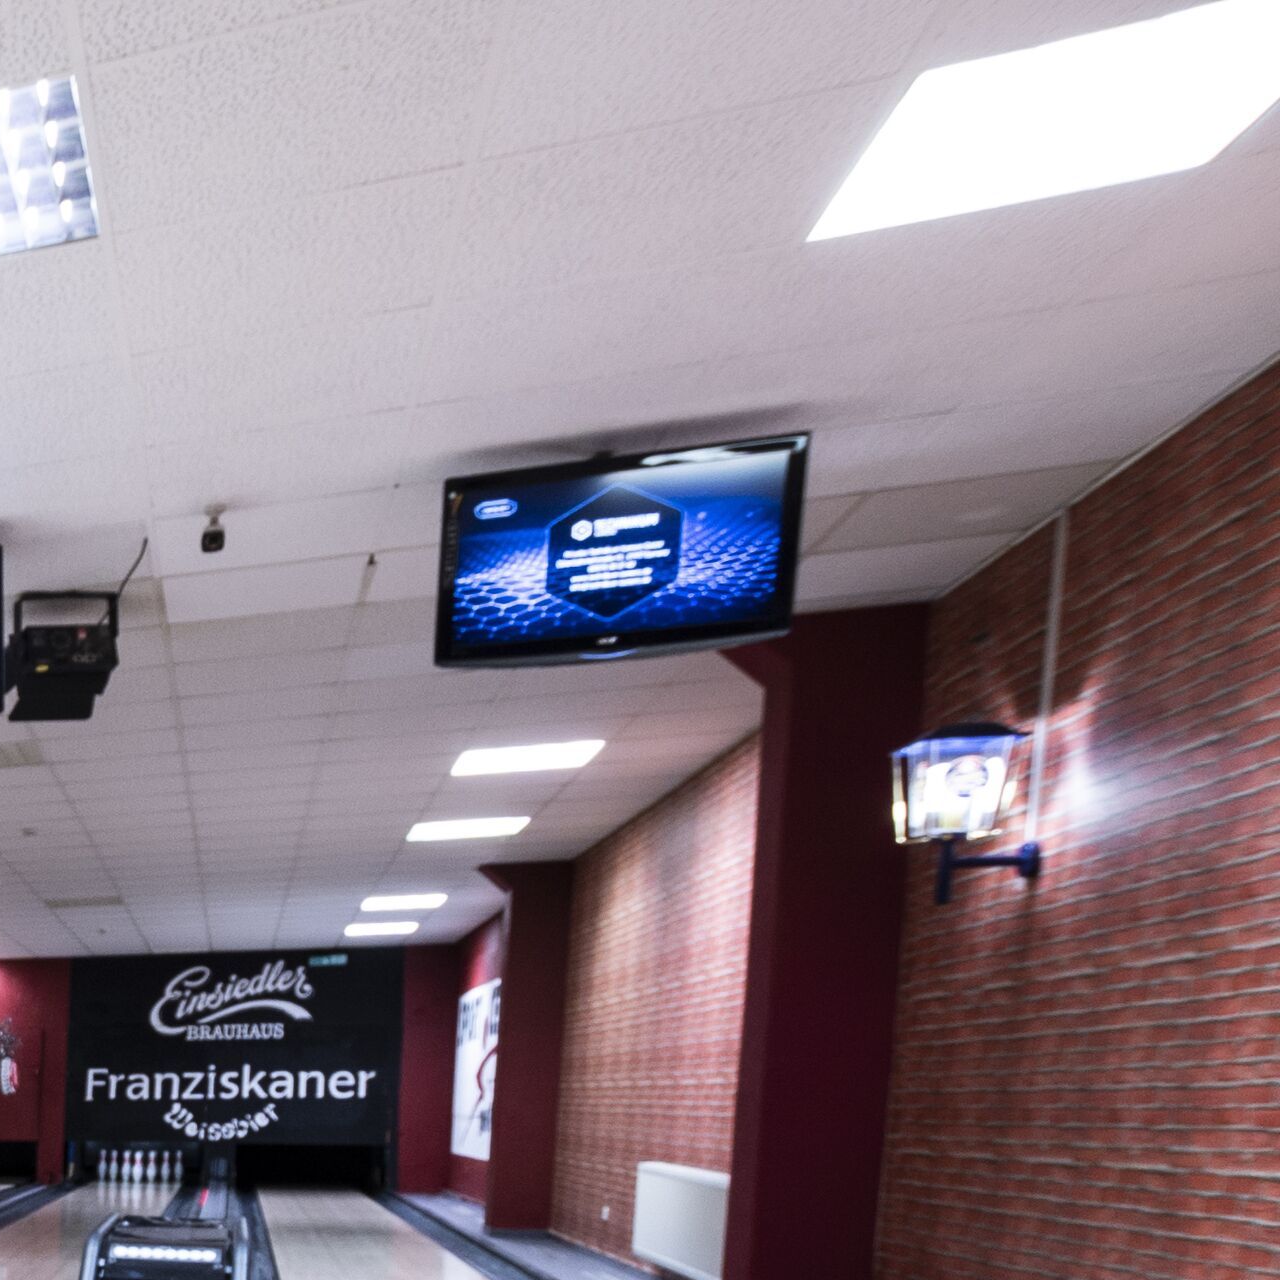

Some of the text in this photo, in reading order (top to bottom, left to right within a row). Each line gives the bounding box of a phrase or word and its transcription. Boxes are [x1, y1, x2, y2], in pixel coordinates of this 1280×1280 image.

[149, 959, 315, 1035] Einsiedler
[186, 1022, 285, 1041] BRAUHAUS
[85, 1063, 377, 1101] Franziskaner
[163, 1102, 280, 1141] Weissbier
